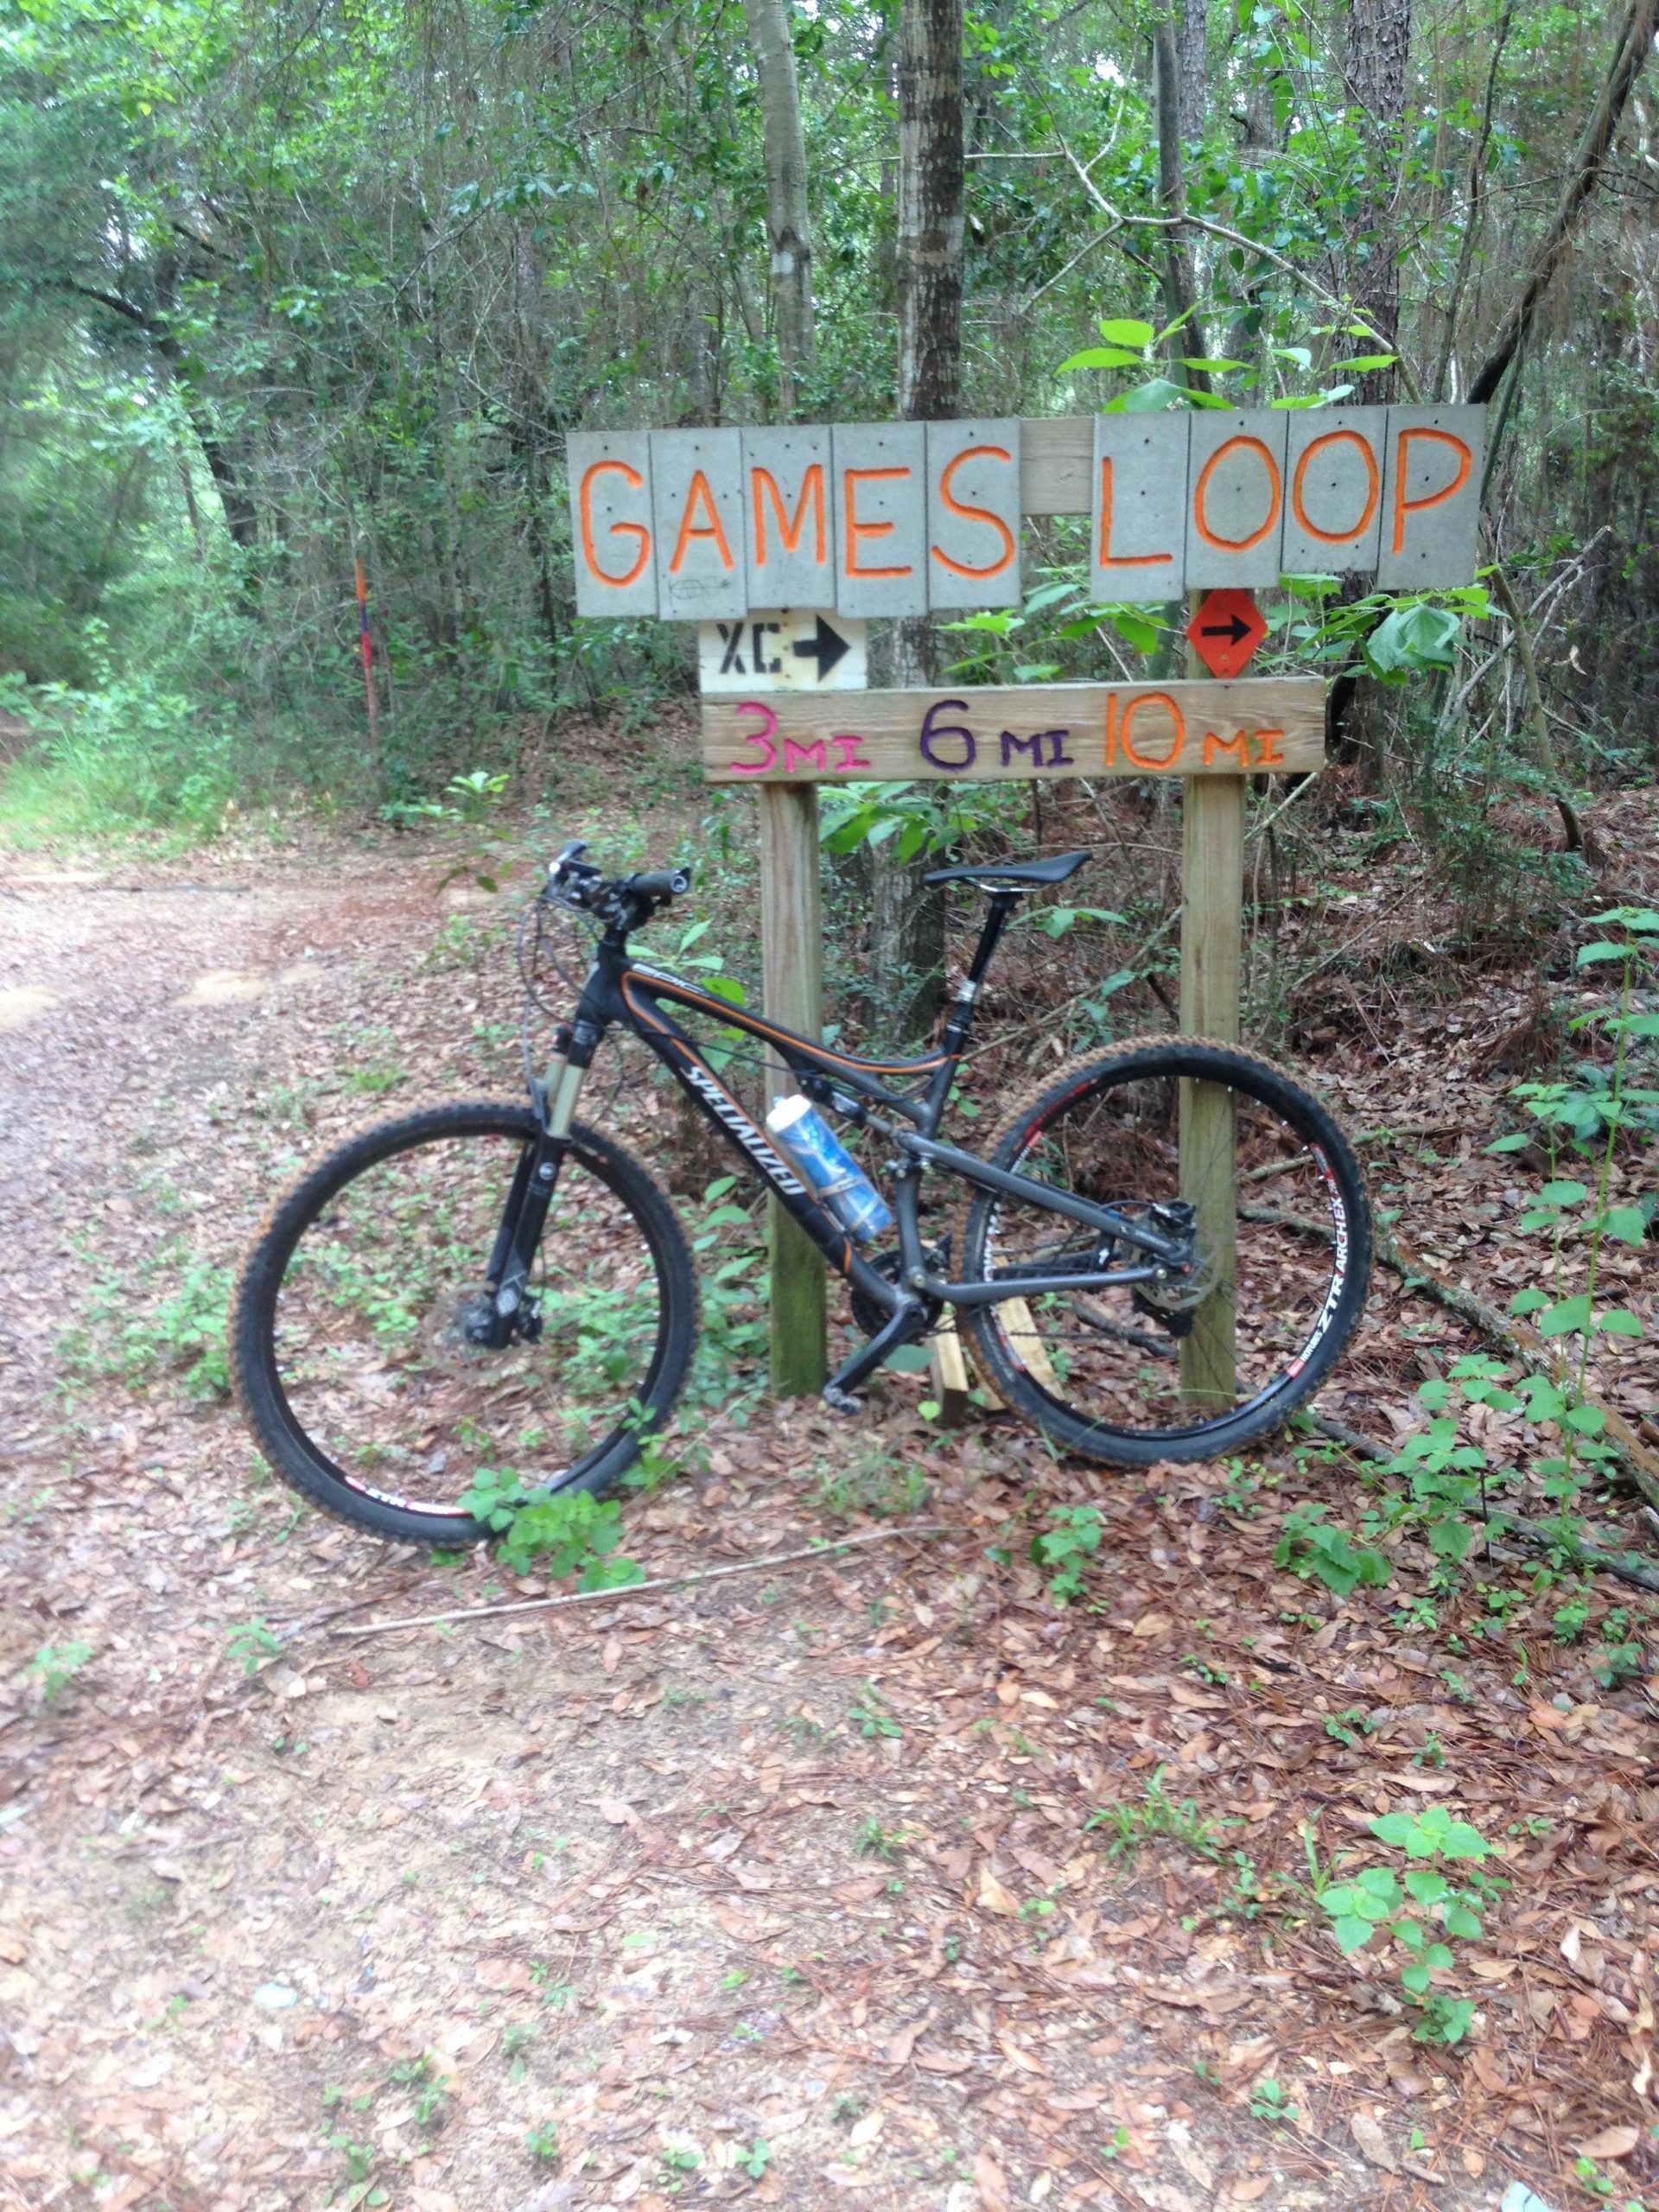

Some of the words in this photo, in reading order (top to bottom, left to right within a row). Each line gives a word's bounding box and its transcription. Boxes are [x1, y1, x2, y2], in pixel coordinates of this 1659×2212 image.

[580, 446, 1015, 588] GAMES
[1099, 429, 1472, 568] LOOP
[716, 621, 782, 674] XC
[730, 701, 778, 774] 3
[783, 734, 871, 772] MI
[918, 699, 976, 772] 6
[1000, 729, 1074, 767] MI
[1104, 691, 1185, 771] 10
[1202, 728, 1285, 769] MI
[680, 1065, 806, 1196] SPECIALIZED
[1332, 1198, 1346, 1219] EX
[1336, 1221, 1348, 1273] ARCH
[1318, 1275, 1344, 1334] ZTR
